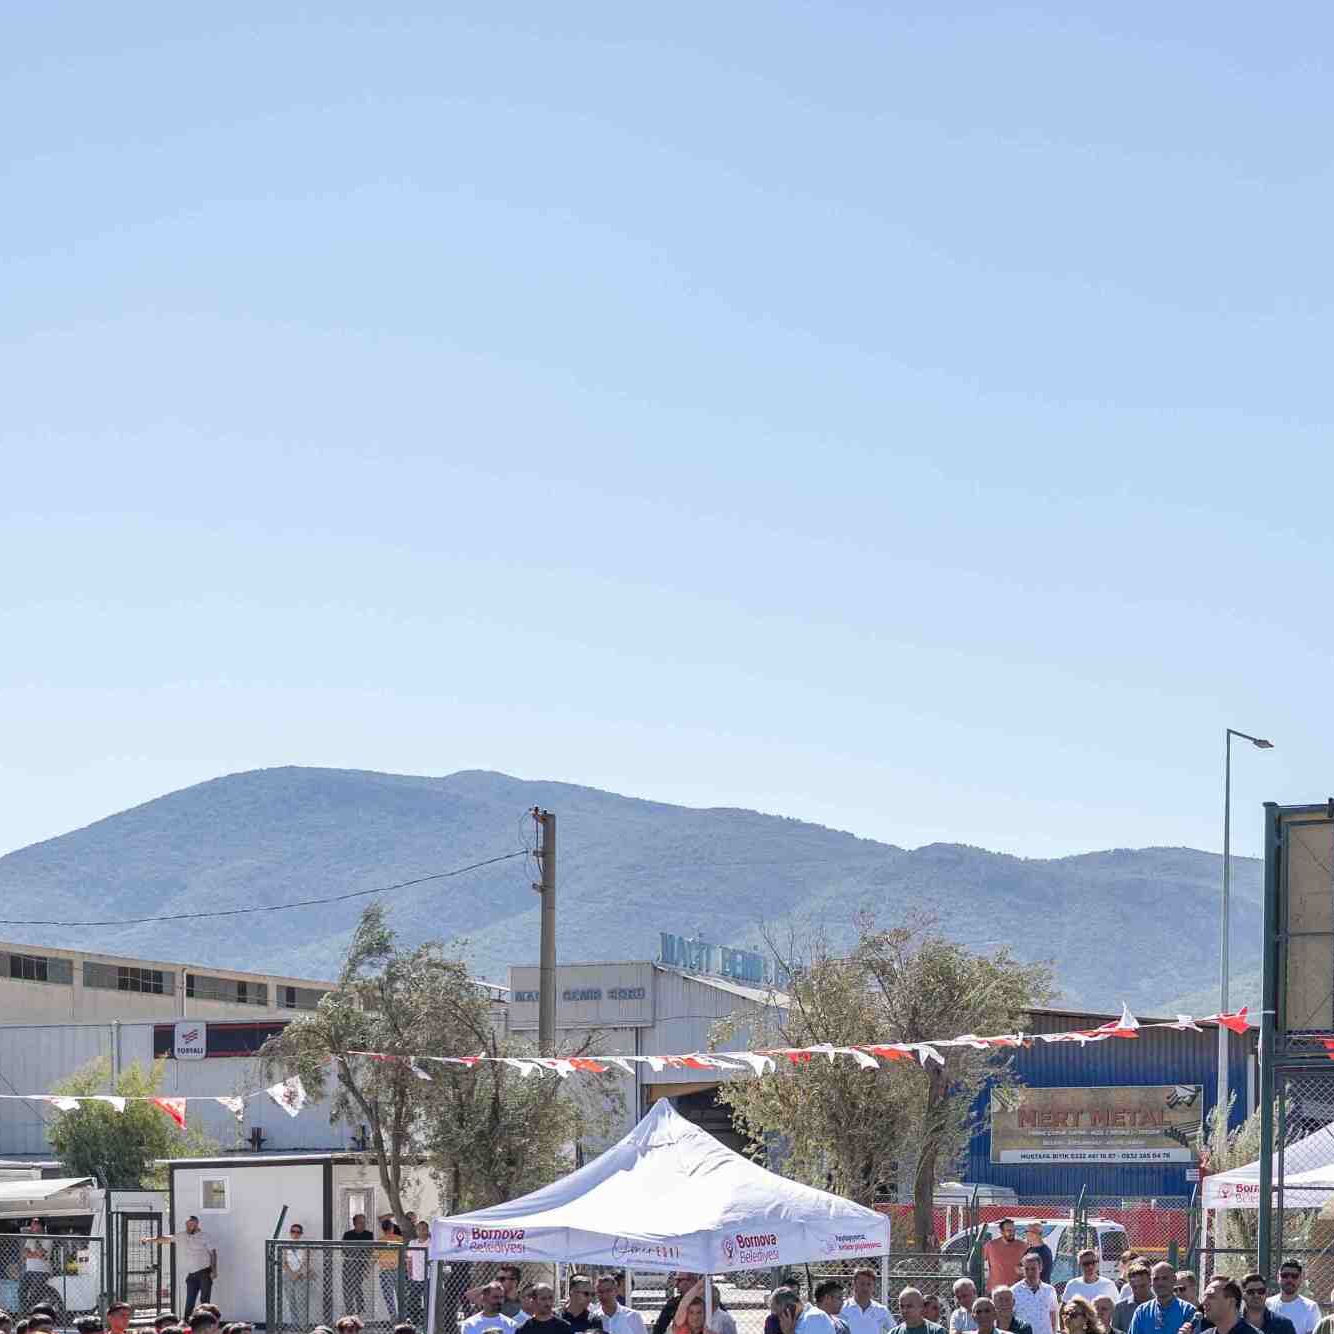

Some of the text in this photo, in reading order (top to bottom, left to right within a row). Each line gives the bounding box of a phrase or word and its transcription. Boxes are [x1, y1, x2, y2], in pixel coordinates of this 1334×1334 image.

[1090, 1108, 1172, 1127] METAL
[471, 1227, 525, 1240] Bornova
[736, 1233, 778, 1249] Bornova
[470, 1241, 526, 1255] Belediyesi
